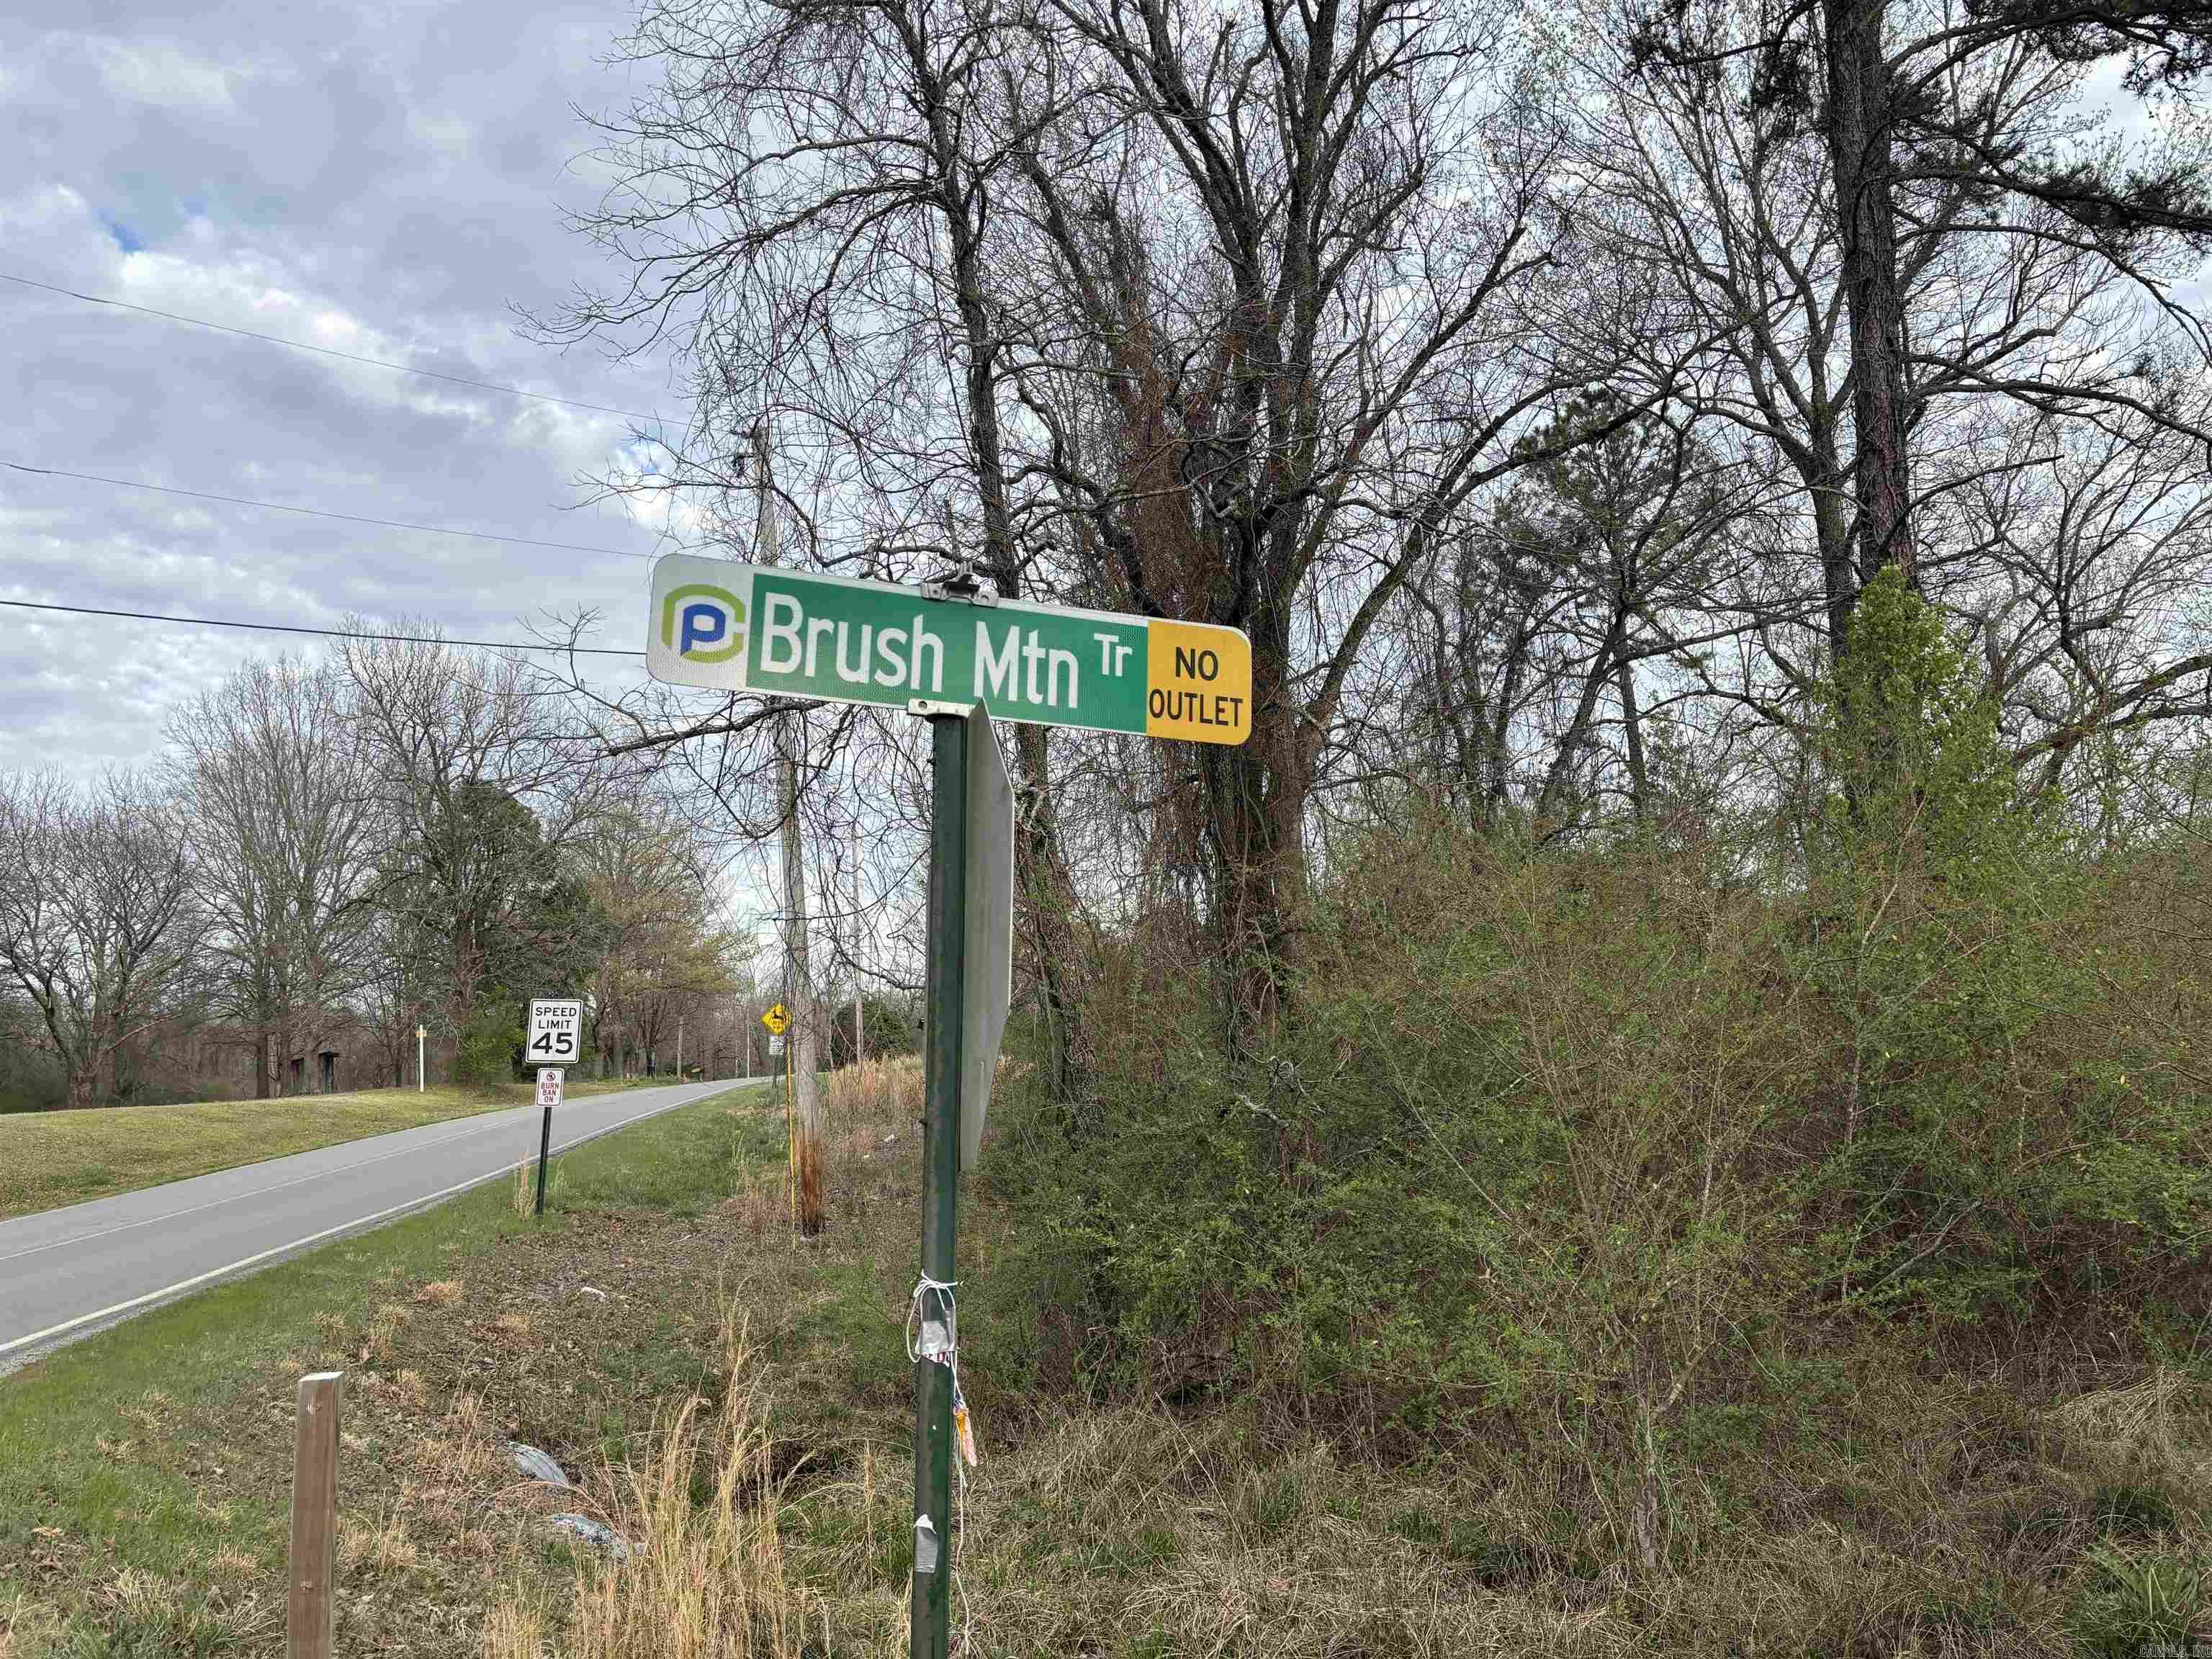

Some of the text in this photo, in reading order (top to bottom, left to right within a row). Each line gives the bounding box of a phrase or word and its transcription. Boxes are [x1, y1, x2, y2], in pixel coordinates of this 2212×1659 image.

[760, 592, 1133, 709] Brush Mtn Tr
[1174, 646, 1219, 681] NO
[1148, 688, 1244, 728] OUTLET
[535, 1007, 577, 1017] SPEED
[538, 1020, 572, 1030] LIMIT
[532, 1032, 573, 1055] 45
